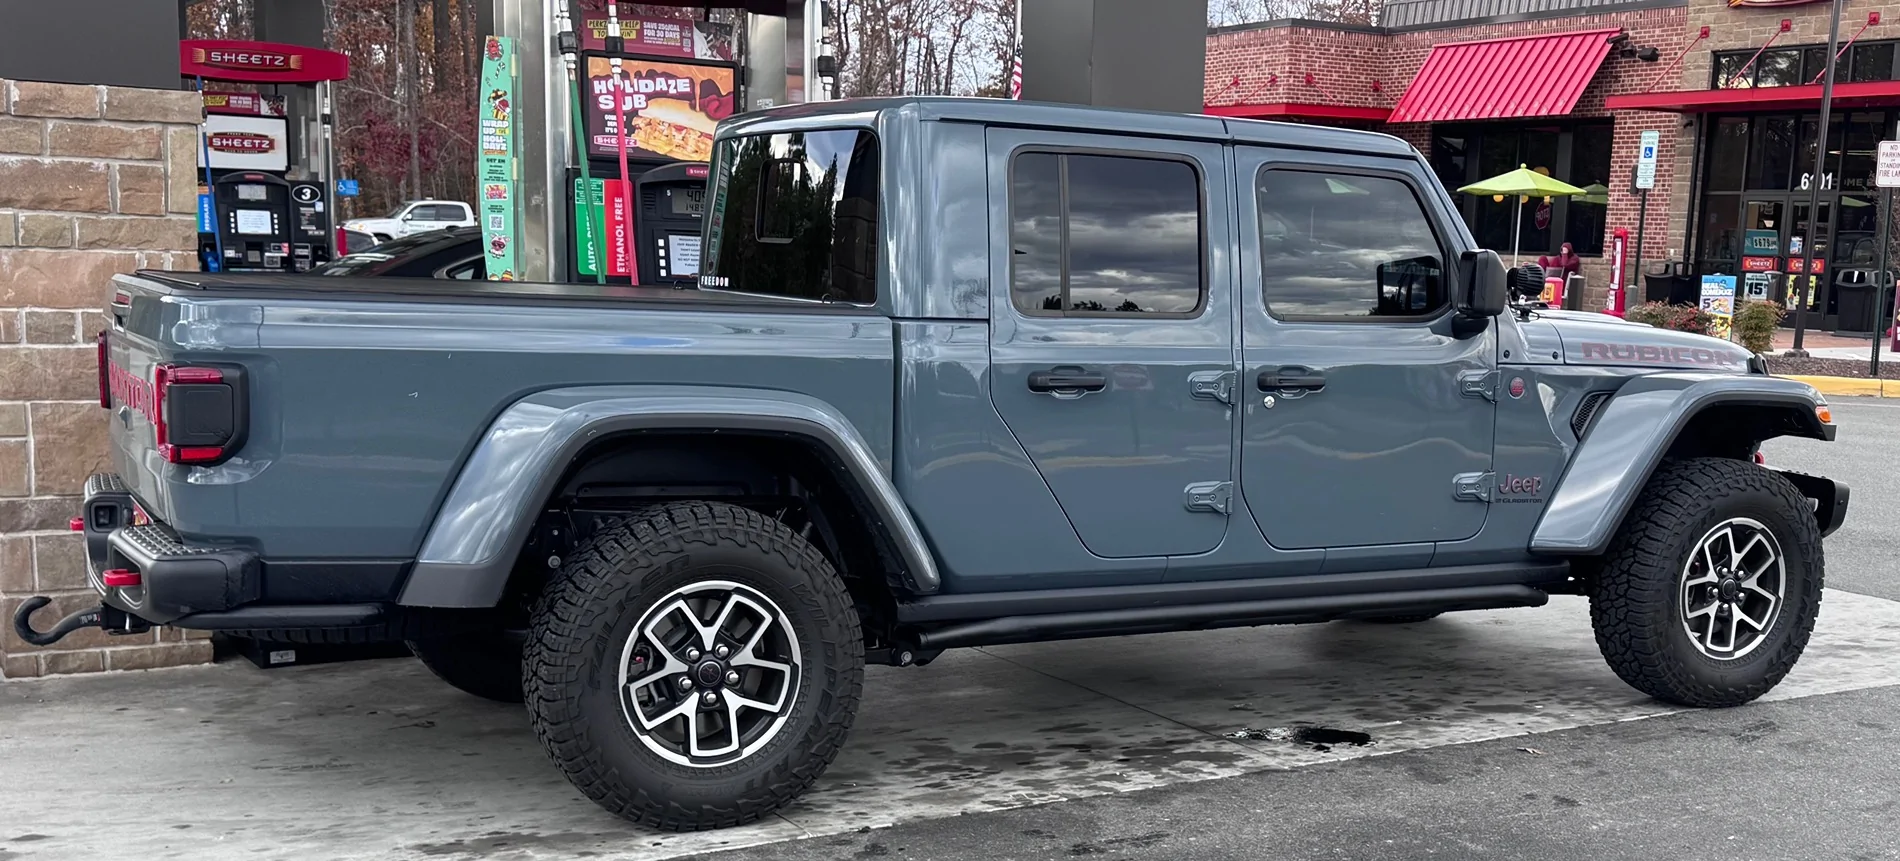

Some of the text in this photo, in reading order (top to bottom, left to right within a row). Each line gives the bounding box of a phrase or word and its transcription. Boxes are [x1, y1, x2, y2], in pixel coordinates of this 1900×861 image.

[210, 51, 286, 66] SHEETZ
[593, 77, 691, 95] HOLIDAZE
[482, 119, 509, 128] WRAP
[483, 127, 496, 135] UP
[211, 137, 270, 148] SHEETZ
[301, 188, 311, 200] 3
[614, 196, 625, 273] ETHANOL FREE
[701, 275, 729, 287] FREEDOM
[1581, 342, 1740, 366] RUBICON
[1500, 474, 1541, 496] Jeep
